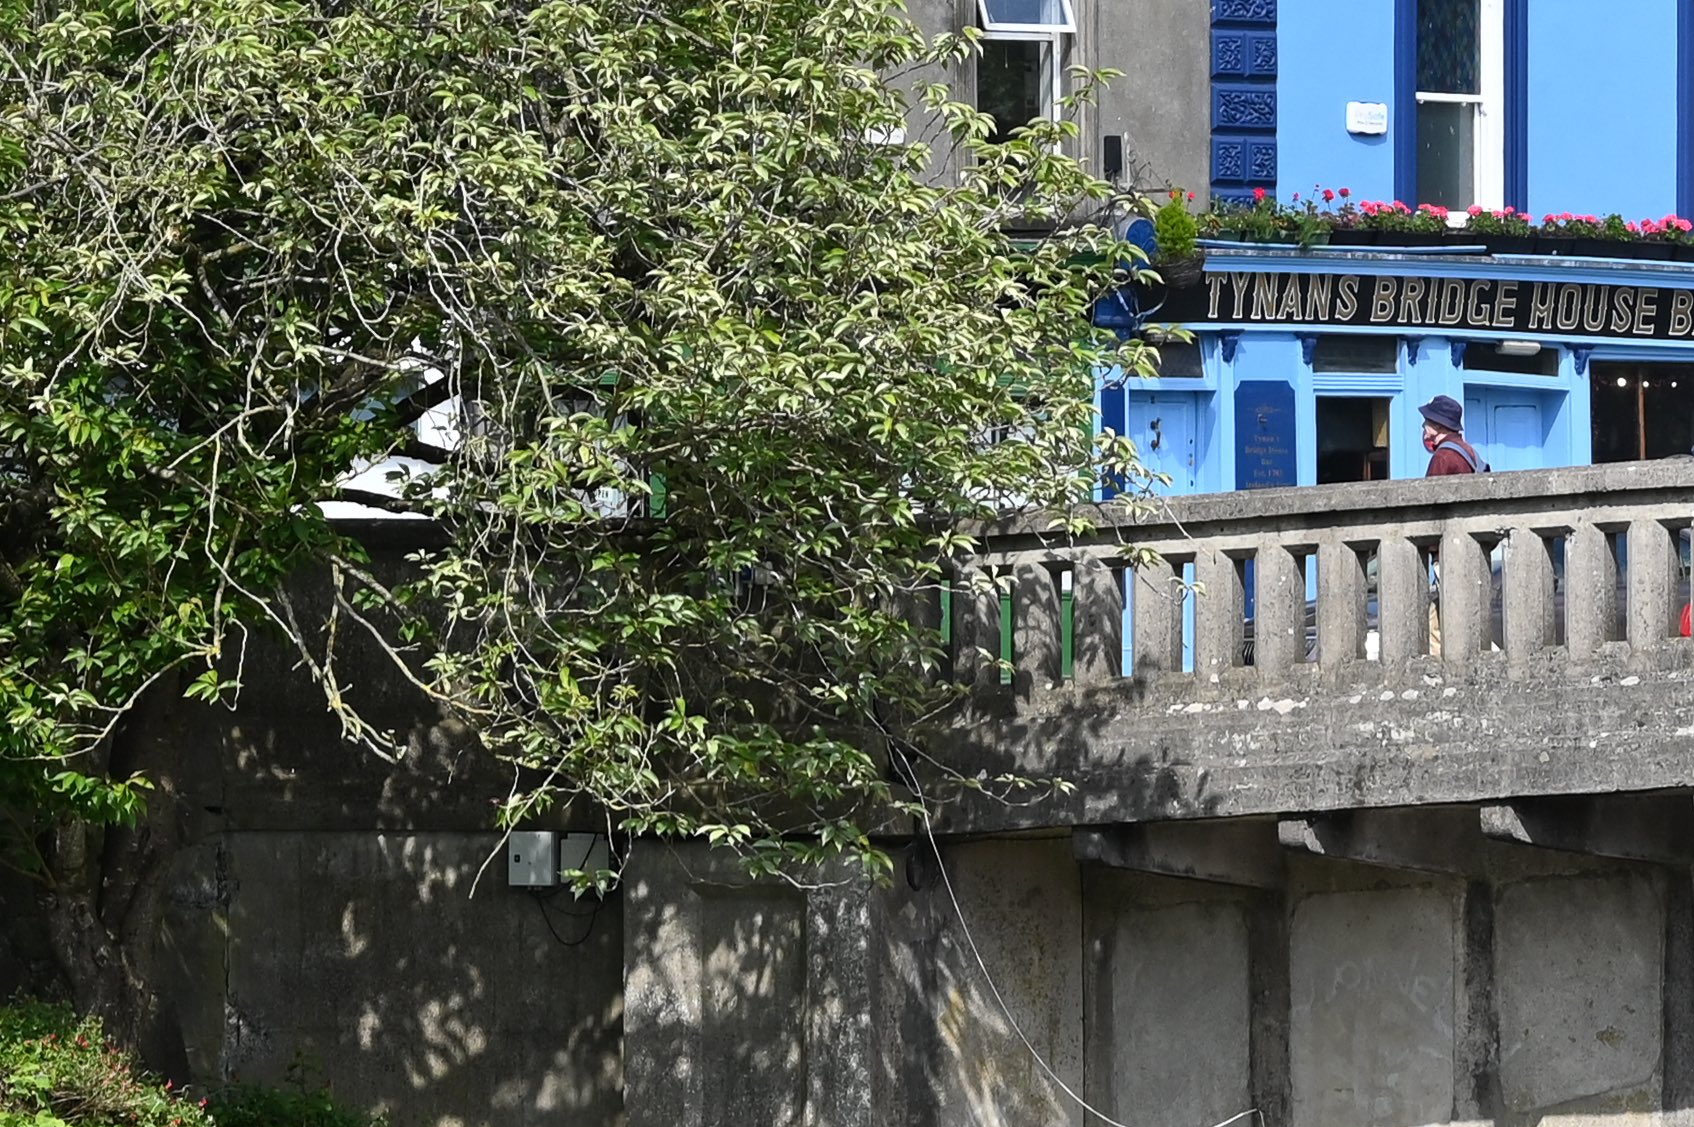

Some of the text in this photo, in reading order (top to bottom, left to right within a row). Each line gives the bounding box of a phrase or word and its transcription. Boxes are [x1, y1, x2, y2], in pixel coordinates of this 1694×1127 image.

[1205, 271, 1359, 320] TYNANS
[1370, 276, 1519, 327] BRIDGE
[1528, 281, 1658, 335] HOUSE
